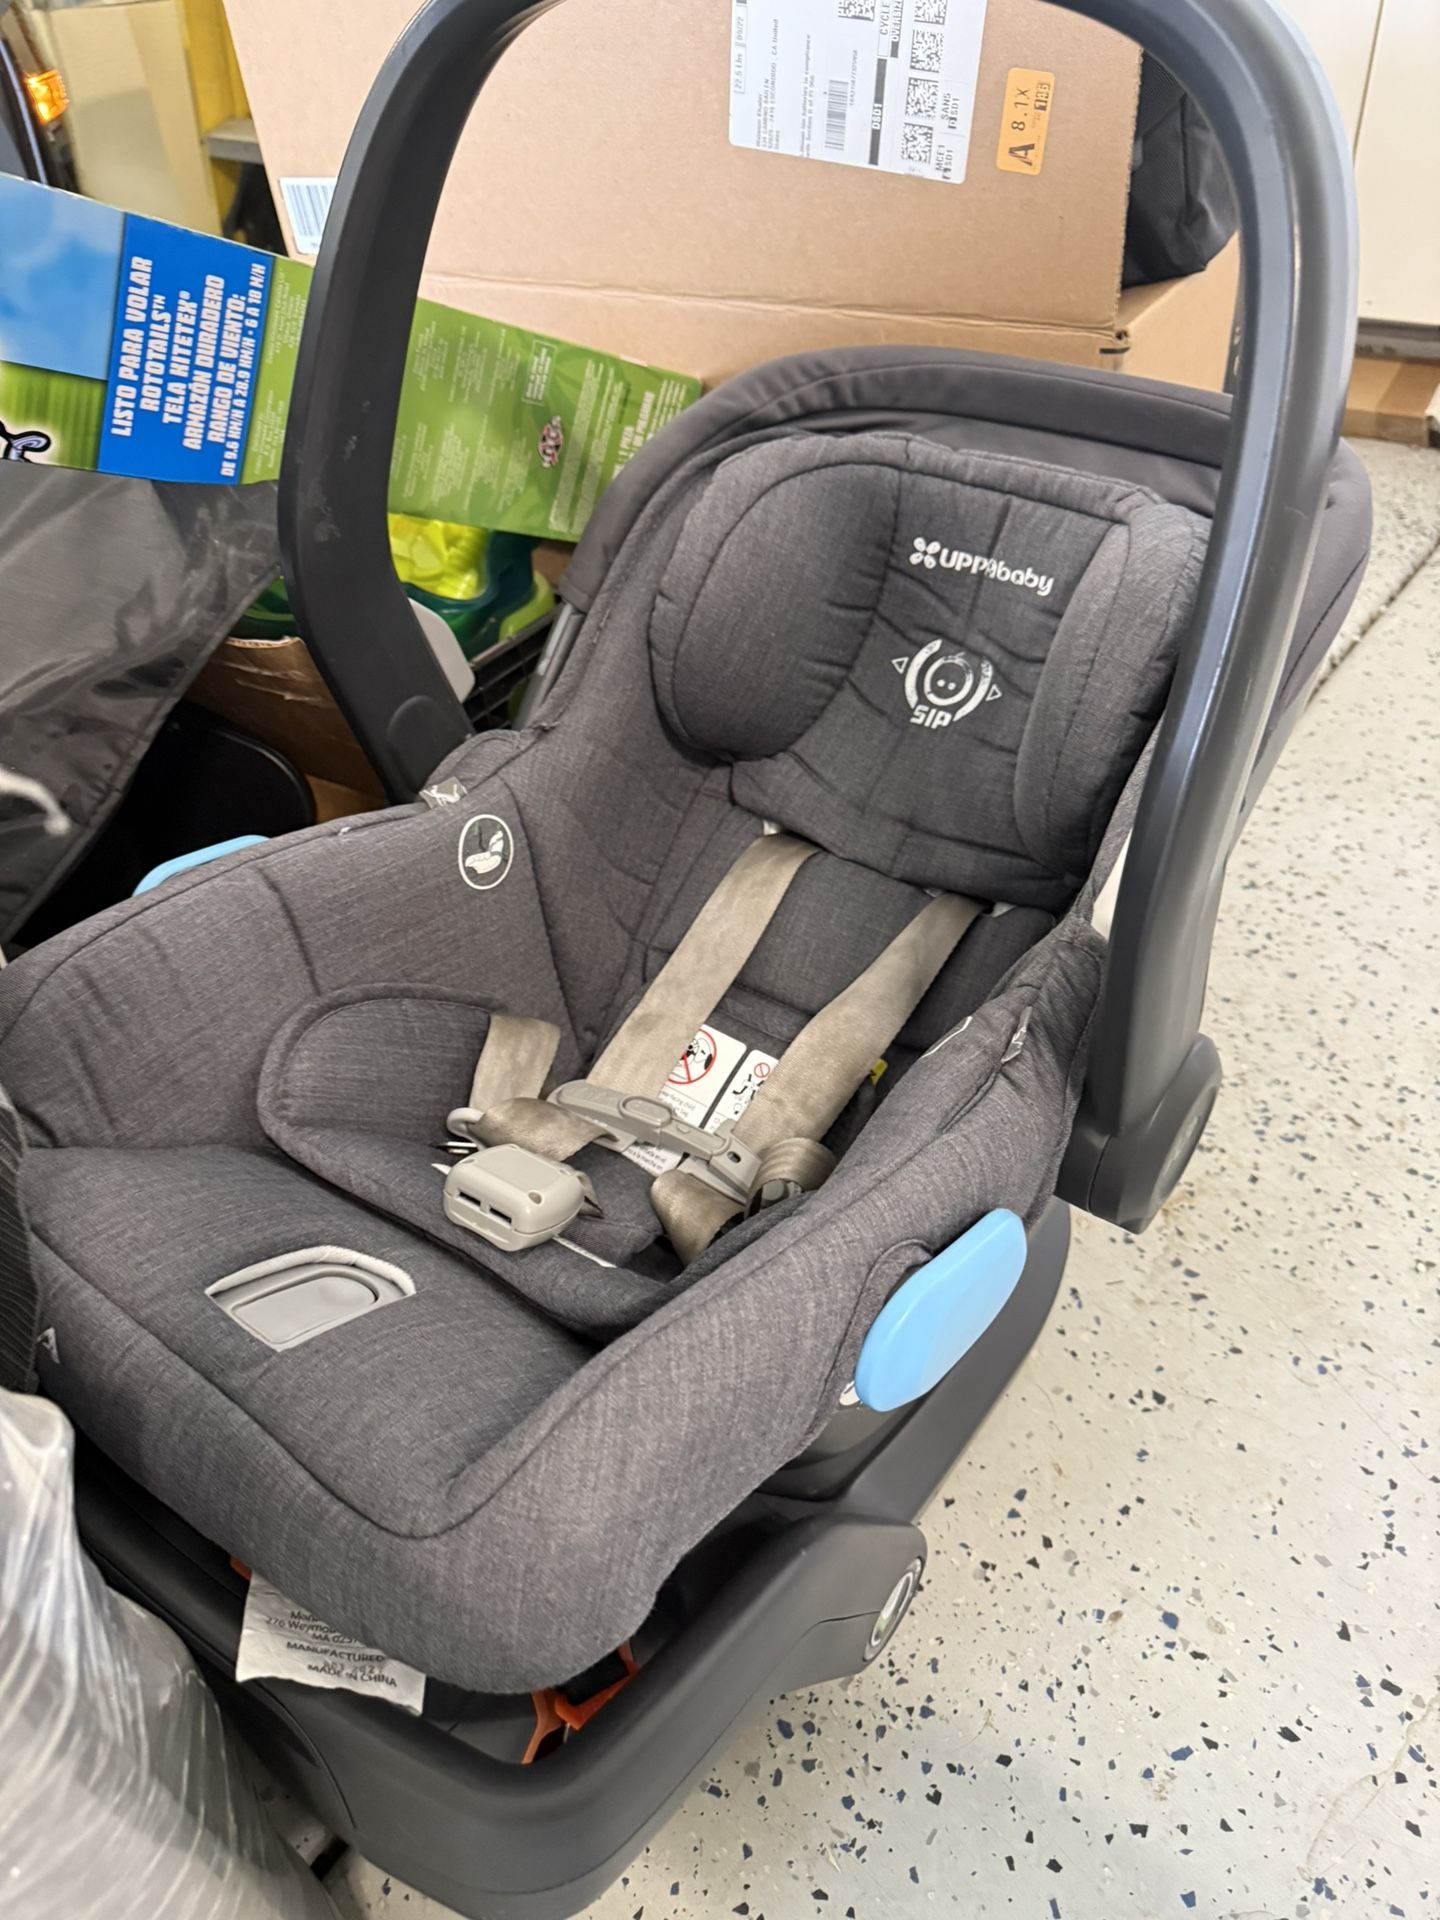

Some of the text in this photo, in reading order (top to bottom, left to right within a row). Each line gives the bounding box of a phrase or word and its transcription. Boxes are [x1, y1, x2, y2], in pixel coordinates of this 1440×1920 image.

[1008, 143, 1036, 167] A
[249, 263, 266, 289] M/H
[247, 289, 262, 304] 18
[244, 318, 258, 328] 6
[246, 306, 261, 317] A
[111, 256, 153, 436] LISTO PARA VOLAR
[182, 274, 225, 450] ARMAZÓN DURADERO
[207, 293, 246, 443] RANGO DE VIENTO:
[234, 369, 251, 397] 28.9
[162, 382, 187, 424] TELA
[232, 398, 247, 409] A
[224, 441, 240, 460] 9.6
[220, 461, 236, 477] DE
[910, 705, 952, 729] SIP
[286, 1641, 386, 1663] MANUFACTURED
[308, 1664, 398, 1689] MADE IN CHINA
